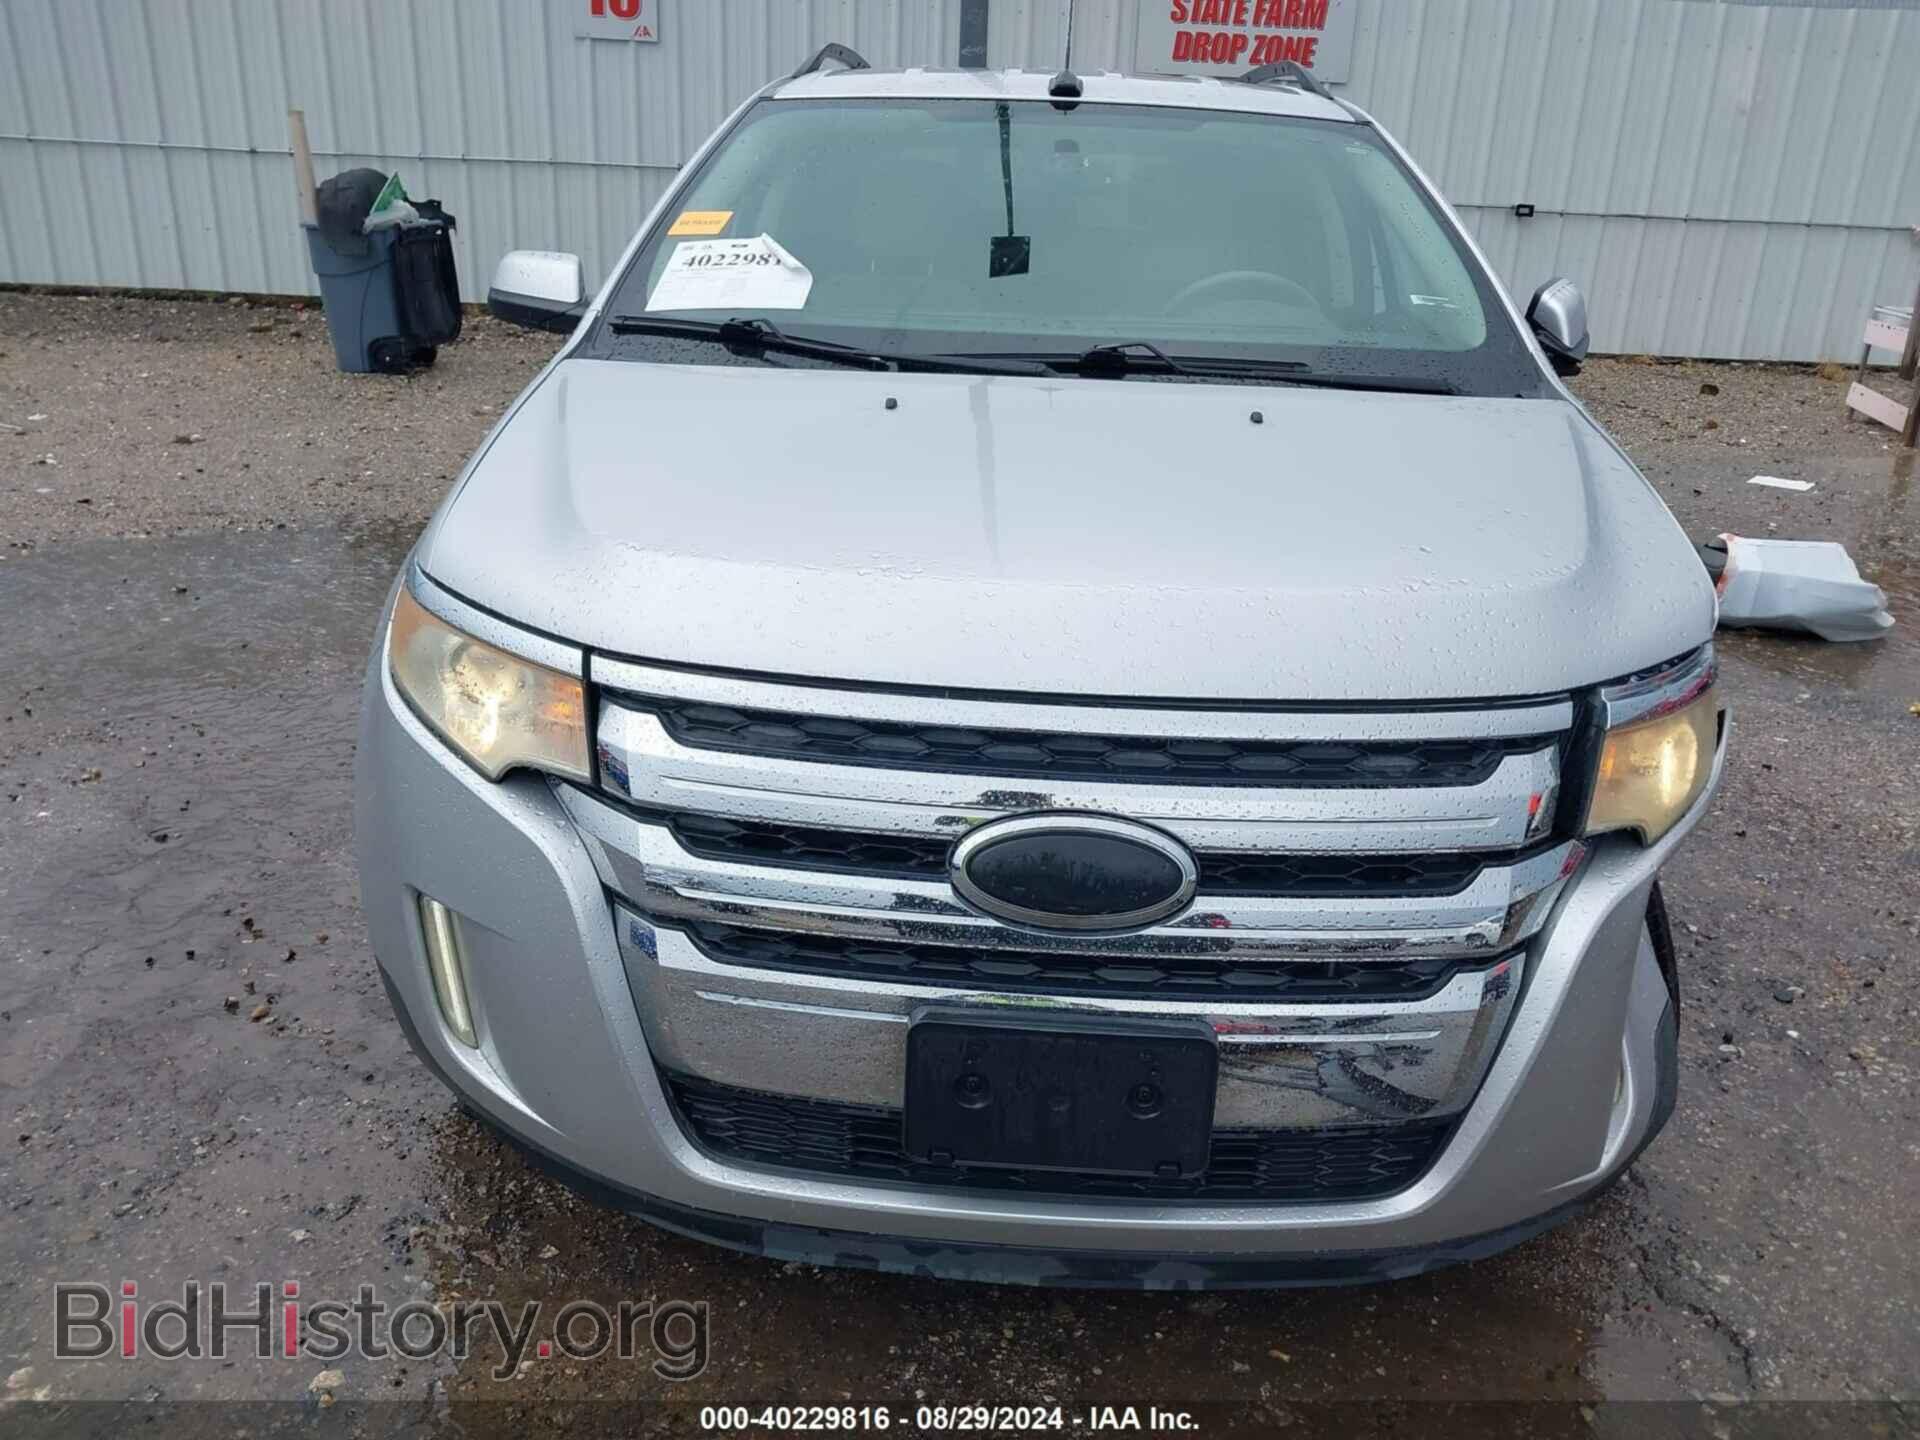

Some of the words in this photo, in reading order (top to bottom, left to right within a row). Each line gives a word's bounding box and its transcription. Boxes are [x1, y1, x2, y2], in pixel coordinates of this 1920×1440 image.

[1170, 0, 1248, 26] STATE
[1251, 0, 1328, 30] FARM
[1171, 31, 1248, 64] DROP
[1249, 35, 1318, 68] ZONE
